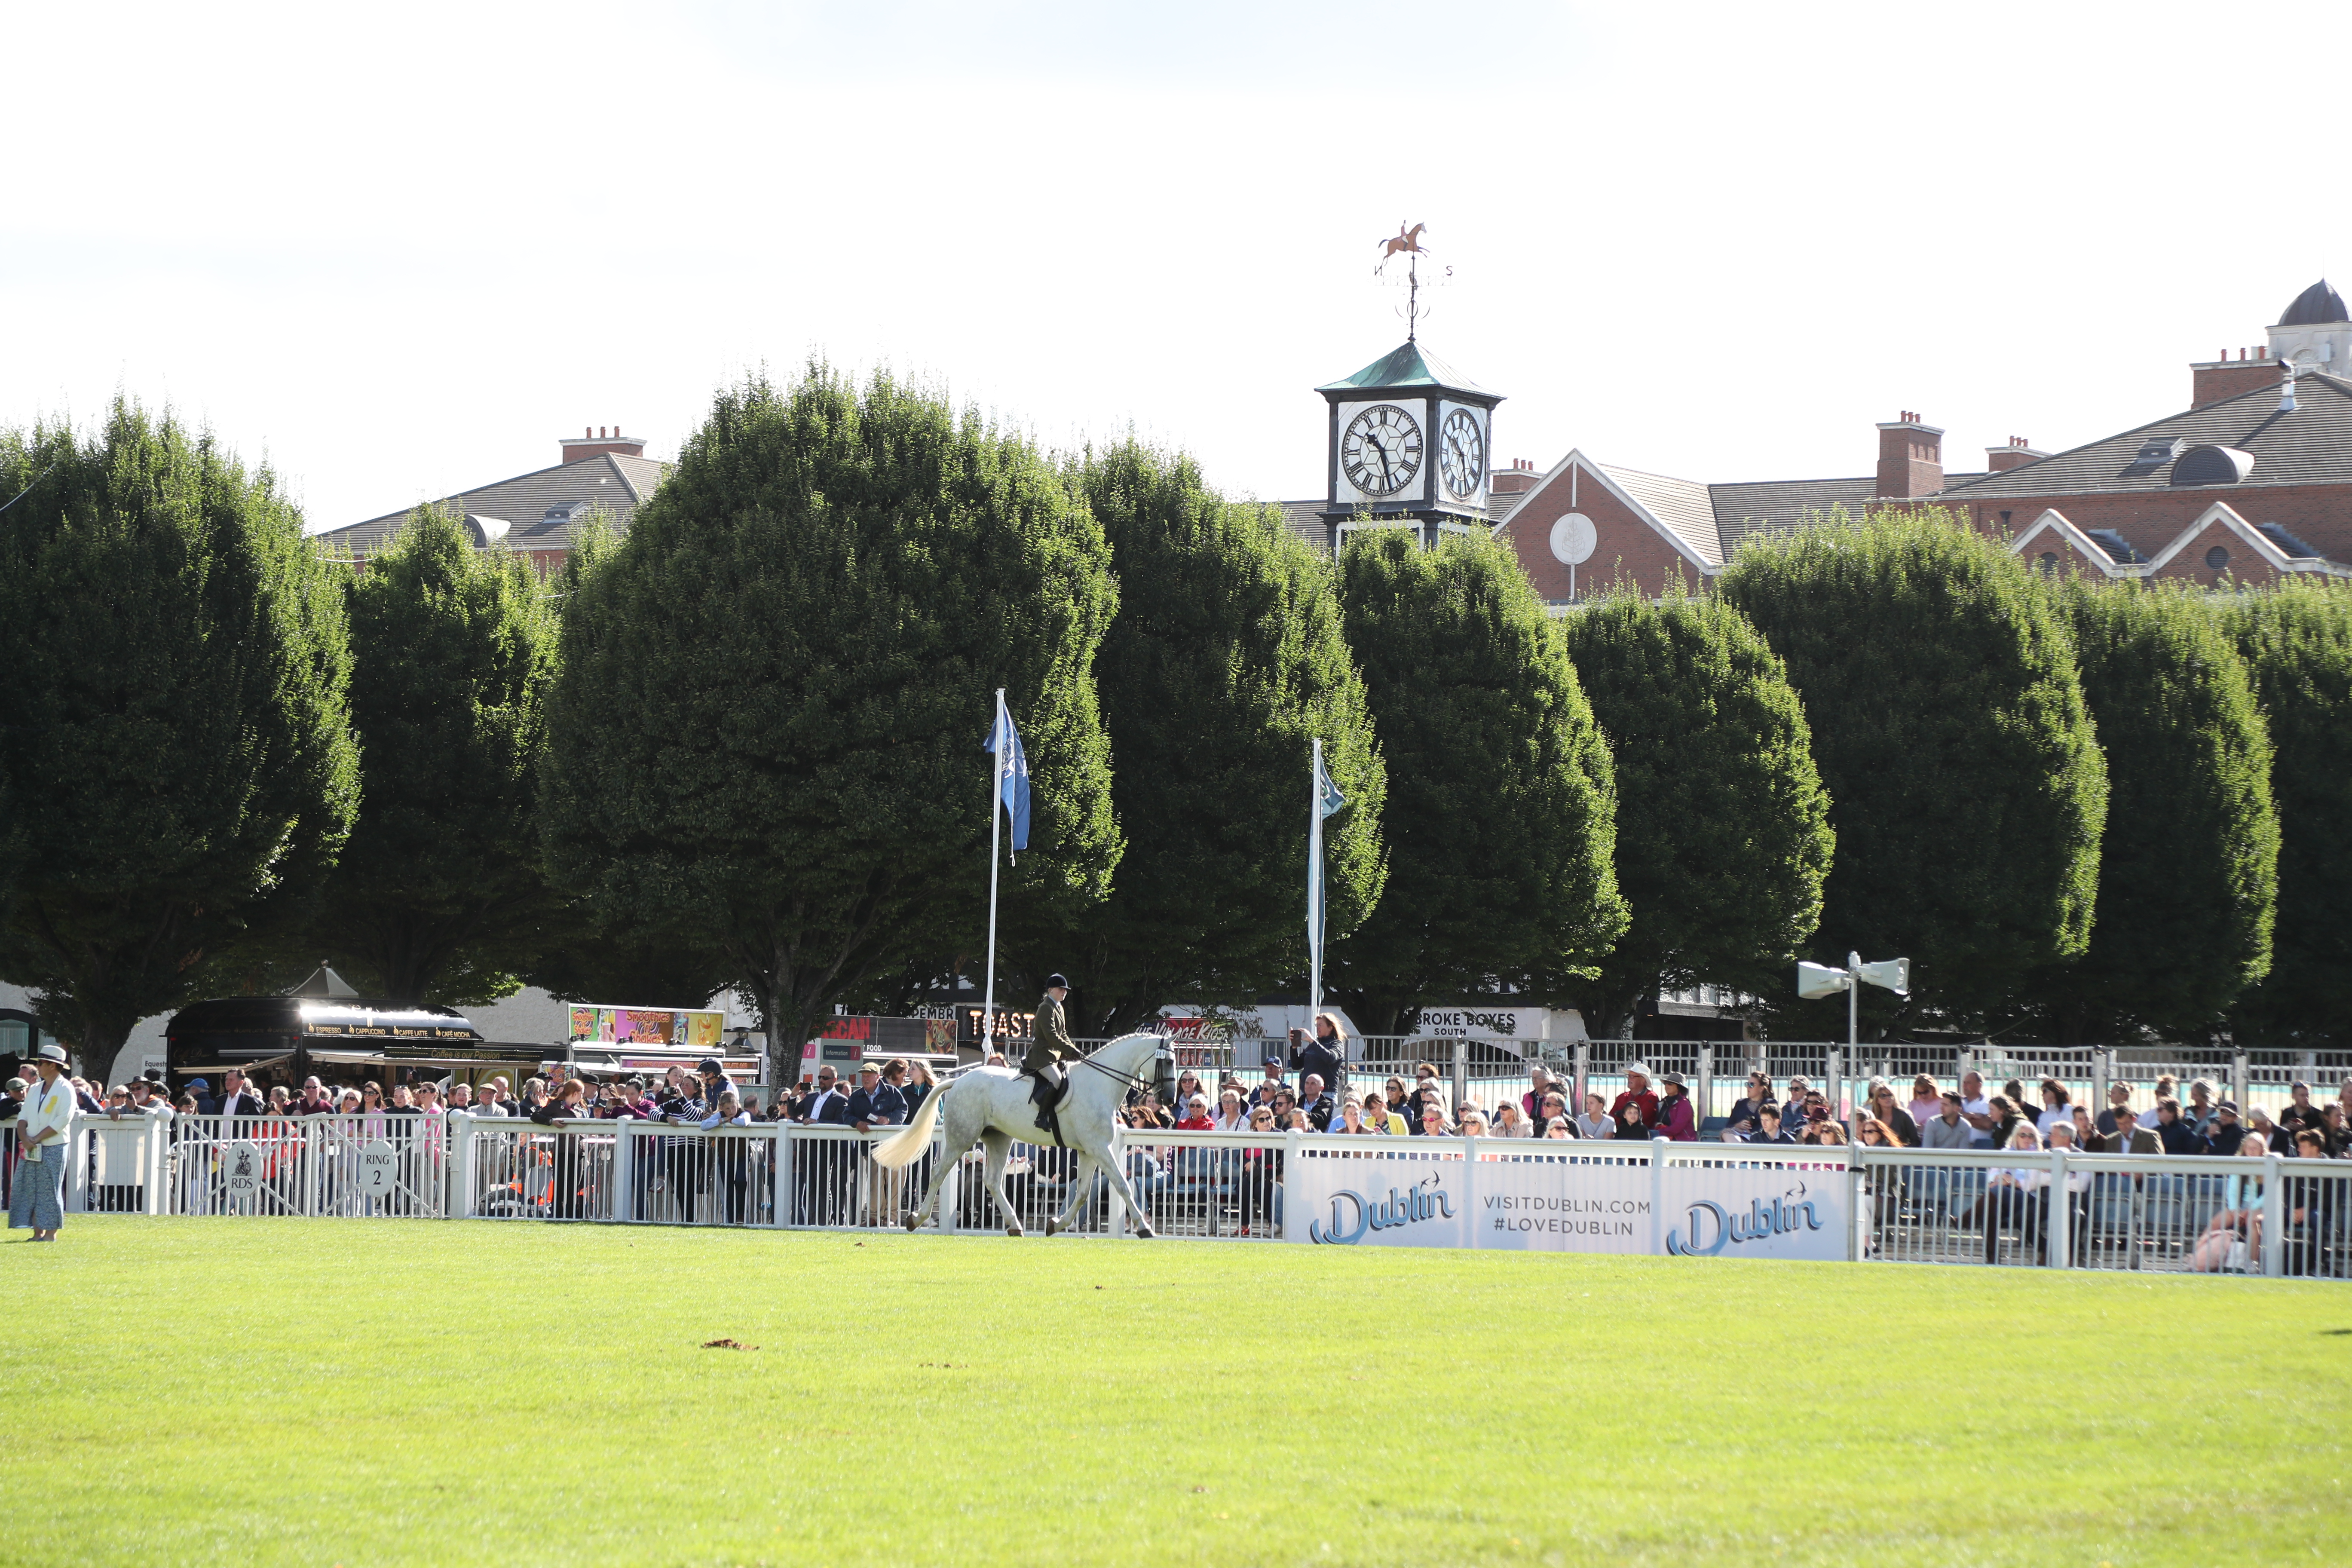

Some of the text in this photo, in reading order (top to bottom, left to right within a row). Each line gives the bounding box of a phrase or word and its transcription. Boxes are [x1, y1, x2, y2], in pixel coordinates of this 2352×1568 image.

[572, 1011, 595, 1021] Smoothies
[626, 1011, 670, 1022] Smoothies
[911, 1008, 954, 1020] PEMBR
[1467, 1013, 1516, 1026] BOXES
[970, 1010, 1035, 1038] TOAST
[630, 1029, 663, 1044] Shakes
[431, 1050, 453, 1058] Coffee
[474, 1051, 500, 1060] Passion
[365, 1154, 390, 1165] RING
[231, 1178, 253, 1189] RDS
[372, 1170, 382, 1185] 2
[1483, 1196, 1651, 1214] VISITDUBLIN.COM
[1310, 1186, 1457, 1245] Dublin
[1494, 1217, 1633, 1236] #LOVEDUBLIN
[1666, 1197, 1824, 1256] Dublin
